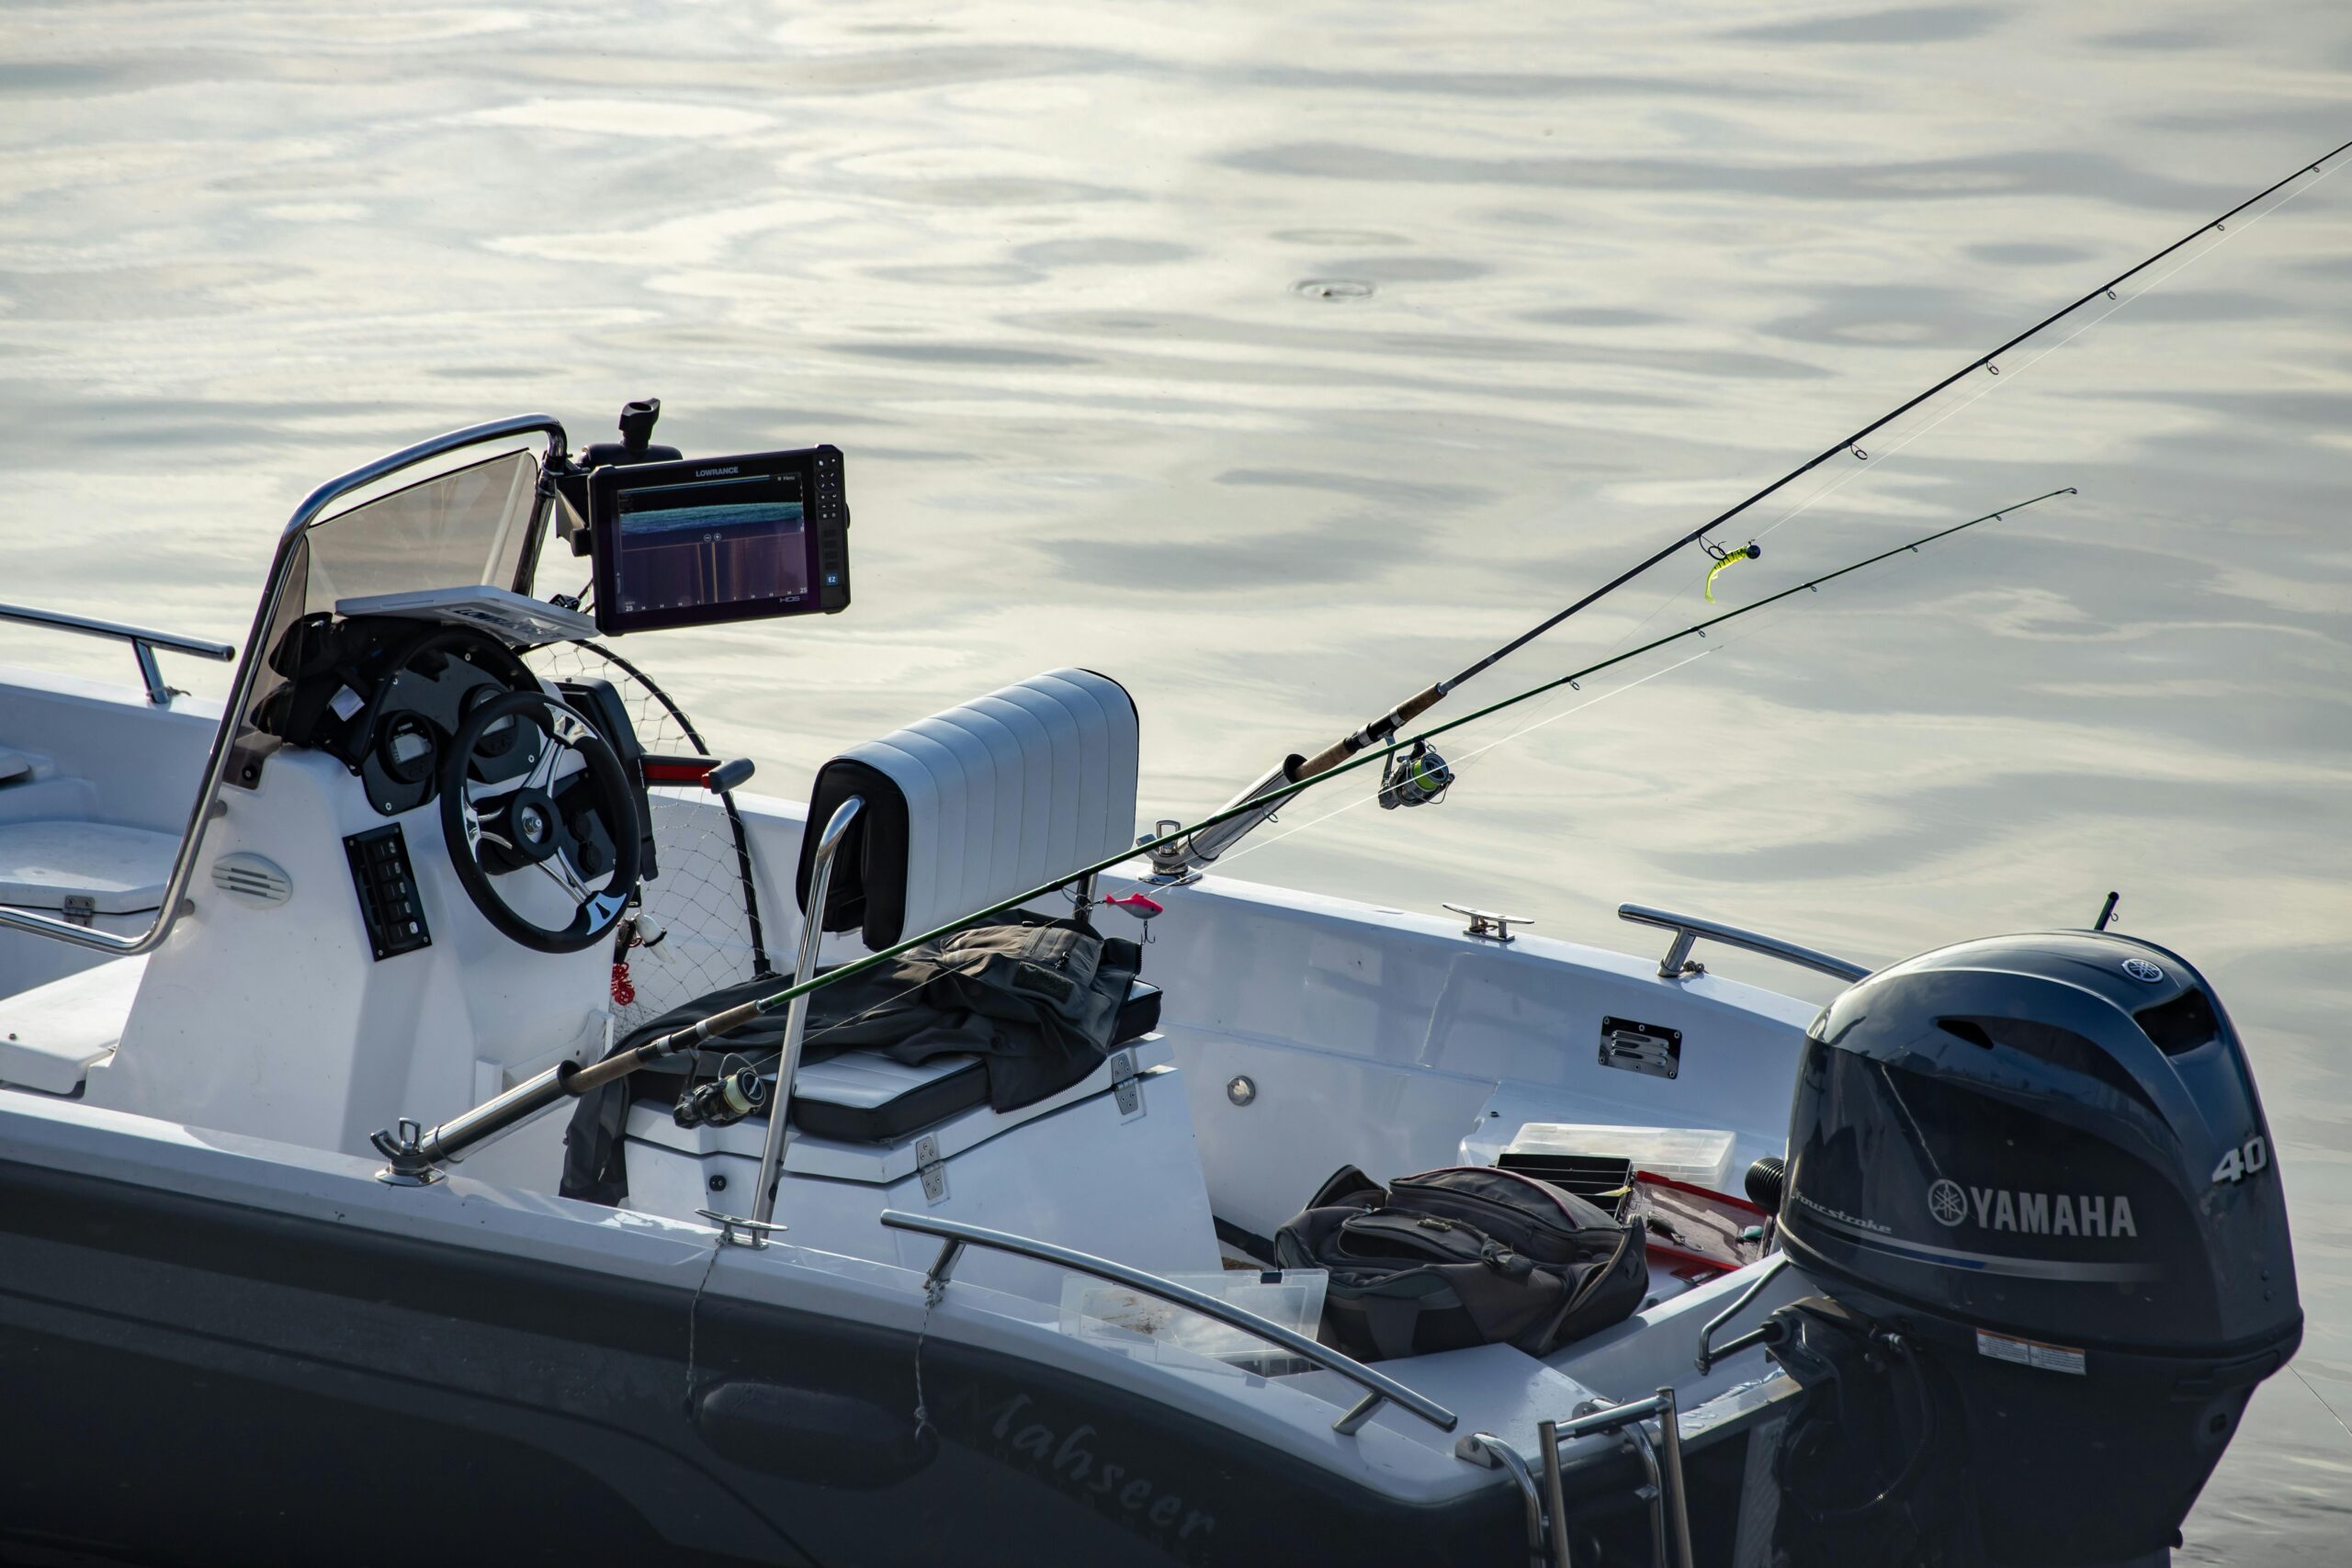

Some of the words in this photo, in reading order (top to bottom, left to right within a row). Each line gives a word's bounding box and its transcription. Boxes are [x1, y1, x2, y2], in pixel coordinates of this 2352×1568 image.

[695, 466, 740, 478] LOWRANCE
[2211, 1135, 2267, 1183] 40
[1969, 1186, 2138, 1237] YAMAHA
